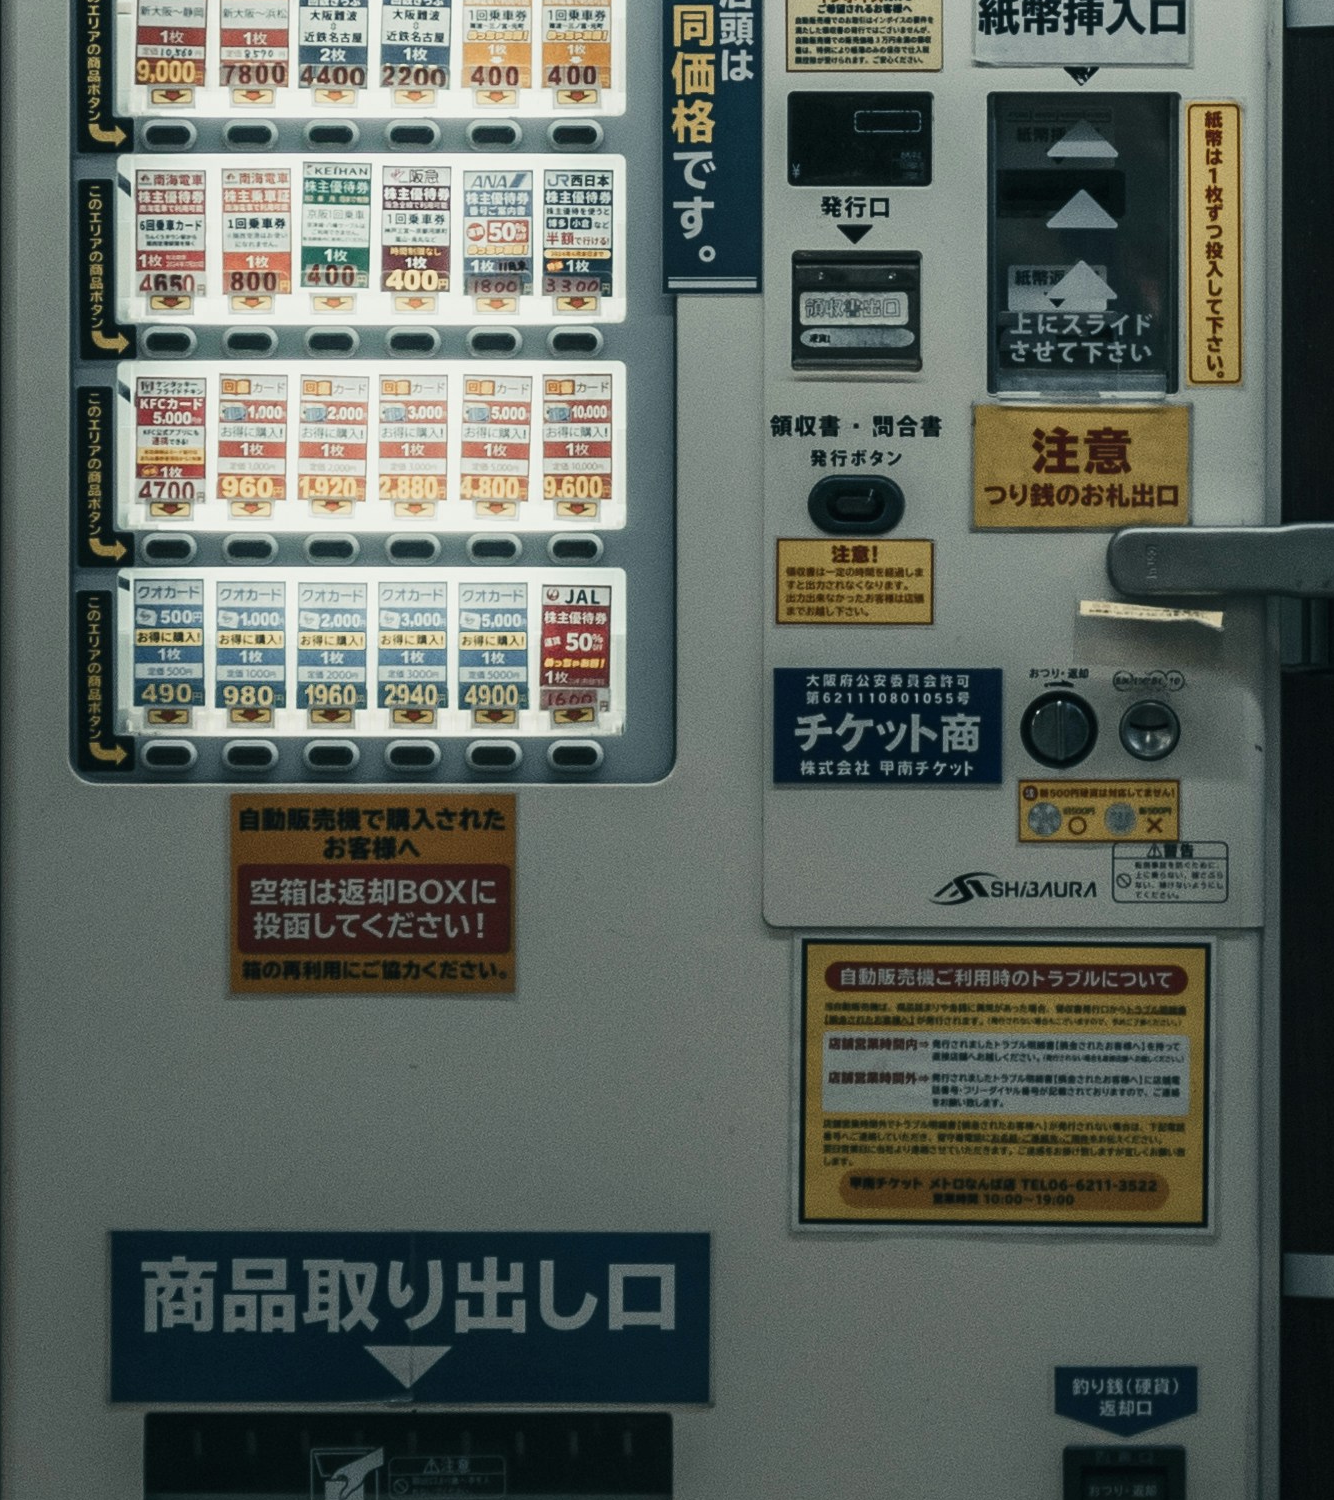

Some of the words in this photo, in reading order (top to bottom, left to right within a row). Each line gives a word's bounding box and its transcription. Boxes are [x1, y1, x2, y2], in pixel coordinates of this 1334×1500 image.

[310, 11, 357, 22] 大阪難波
[393, 10, 440, 21] 大阪難波
[469, 10, 527, 22] 1回乗車券
[548, 10, 606, 22] 1回乗車券
[817, 4, 912, 14] ご希望されるお客様へ
[160, 31, 184, 43] 1枚
[304, 32, 362, 44] 近鉄名古屋
[387, 31, 444, 42] 近鉄名古屋
[320, 48, 345, 62] 2枚
[671, 4, 716, 264] 同価格です。
[239, 173, 289, 183] 南海電車
[314, 165, 369, 175] KEIHAN
[409, 169, 439, 184] 阪急
[154, 175, 203, 186] 南海電車
[304, 180, 369, 193] 株主優待券
[472, 175, 506, 189] ANA
[548, 175, 609, 187] JR西日本
[138, 191, 202, 204] 株主優待券
[384, 187, 450, 200] 株主優待券
[546, 191, 611, 204] 株主優待券
[821, 196, 890, 219] 発行口
[140, 220, 202, 231] 6回乗車カード
[228, 218, 286, 229] 1回乗車券
[387, 214, 445, 225] 1回乗車券
[1205, 111, 1225, 380] 紙幣は1枚ずつ投入して下さい。
[89, 185, 102, 328] このエリアの商品ボタン
[385, 270, 449, 291] 400円
[805, 299, 902, 318] 領収書出口
[1010, 313, 1152, 335] 上にスライド
[1010, 340, 1152, 364] させて下さい
[140, 398, 203, 410] KFCカード
[770, 415, 942, 438] 領収書・問合書
[810, 449, 902, 467] 発行ボタン
[1032, 427, 1132, 475] 注意
[88, 392, 101, 535] このエリアの商品ボタン
[222, 476, 283, 498] 960円
[984, 484, 1178, 508] つり銭のお札出口
[831, 545, 879, 564] 注意!
[138, 585, 201, 599] クオカード
[565, 589, 600, 604] JAL
[160, 610, 203, 624] 500円
[544, 612, 607, 624] 株主優待券
[87, 597, 100, 740] このエリアの商品ボタン
[1029, 668, 1089, 679] おつり・返却
[806, 674, 970, 688] 大阪府公安委員会許可
[141, 683, 203, 703] 490円
[223, 686, 284, 705] 980円
[384, 684, 446, 705] 2940円
[465, 684, 526, 705] 4900円
[794, 712, 980, 753] チケット商
[801, 760, 870, 776] 株式会社
[880, 760, 974, 776] 甲南チケット
[239, 808, 505, 832] 自動販売機で購入された
[323, 836, 420, 859] お客様へ
[249, 878, 497, 906] 空箱は返却BOXに
[254, 912, 485, 939] 投函してください！
[243, 960, 507, 980] 箱の再利用にご協力ください。
[840, 967, 1173, 989] 自動販売機ご利用時のトラブルについて
[141, 1256, 676, 1335] 商品取り出し口
[1072, 1378, 1179, 1396] 釣り銭（硬貨）
[1099, 1401, 1151, 1417] 返却口
